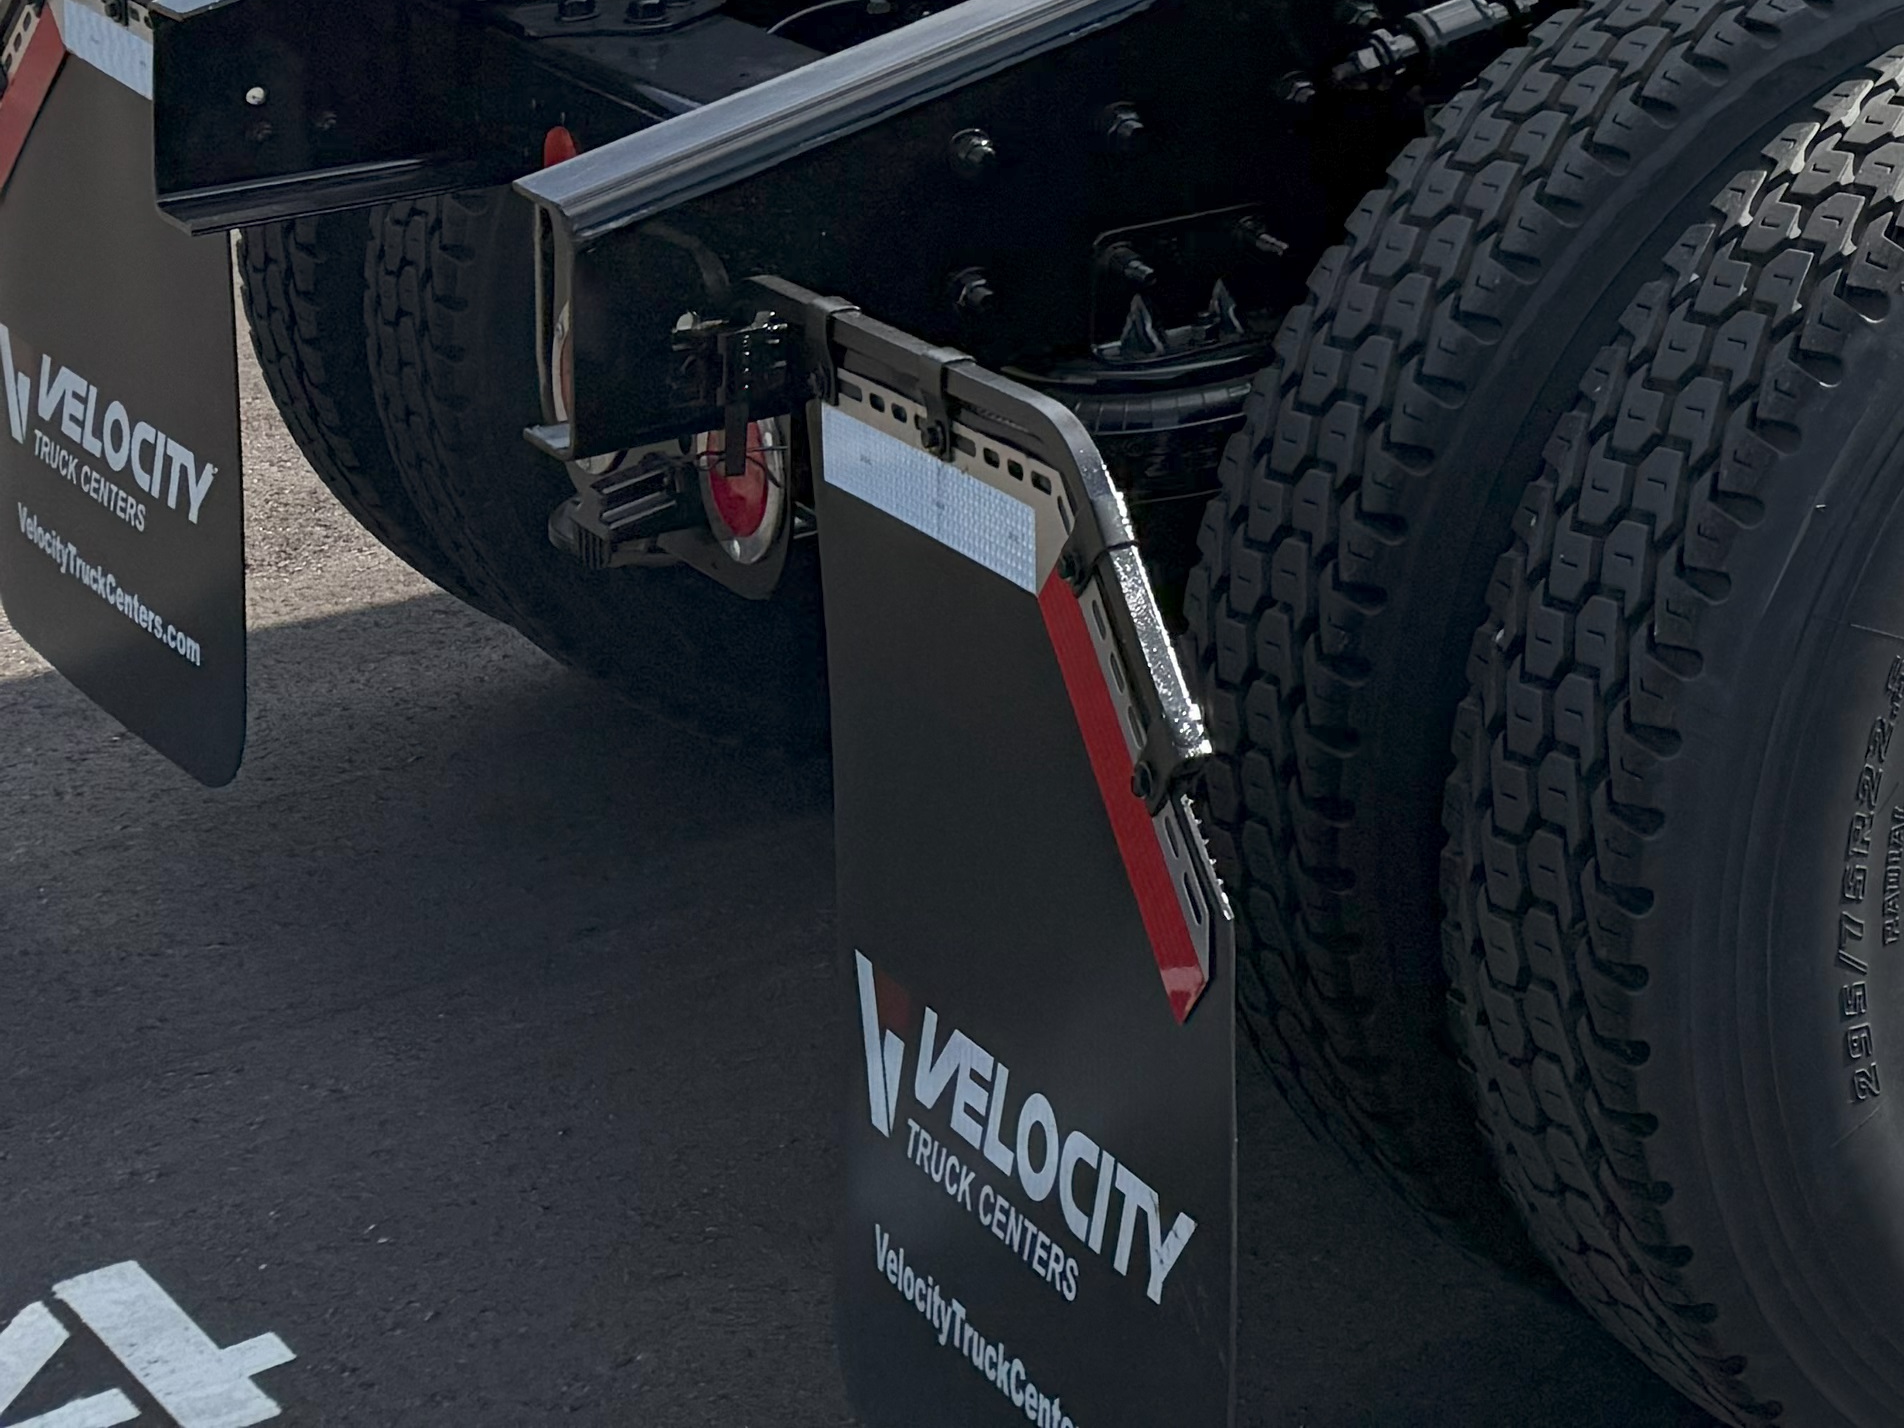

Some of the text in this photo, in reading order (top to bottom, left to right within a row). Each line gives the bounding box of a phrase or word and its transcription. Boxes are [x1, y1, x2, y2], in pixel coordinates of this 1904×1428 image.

[33, 430, 147, 532] TRUCK CENTERS
[38, 355, 215, 524] VELOCITY
[18, 502, 202, 666] VelocityTruckCenters.com
[906, 1118, 1079, 1302] TRUCK CENTERS
[914, 1006, 1198, 1305] VELOCITY
